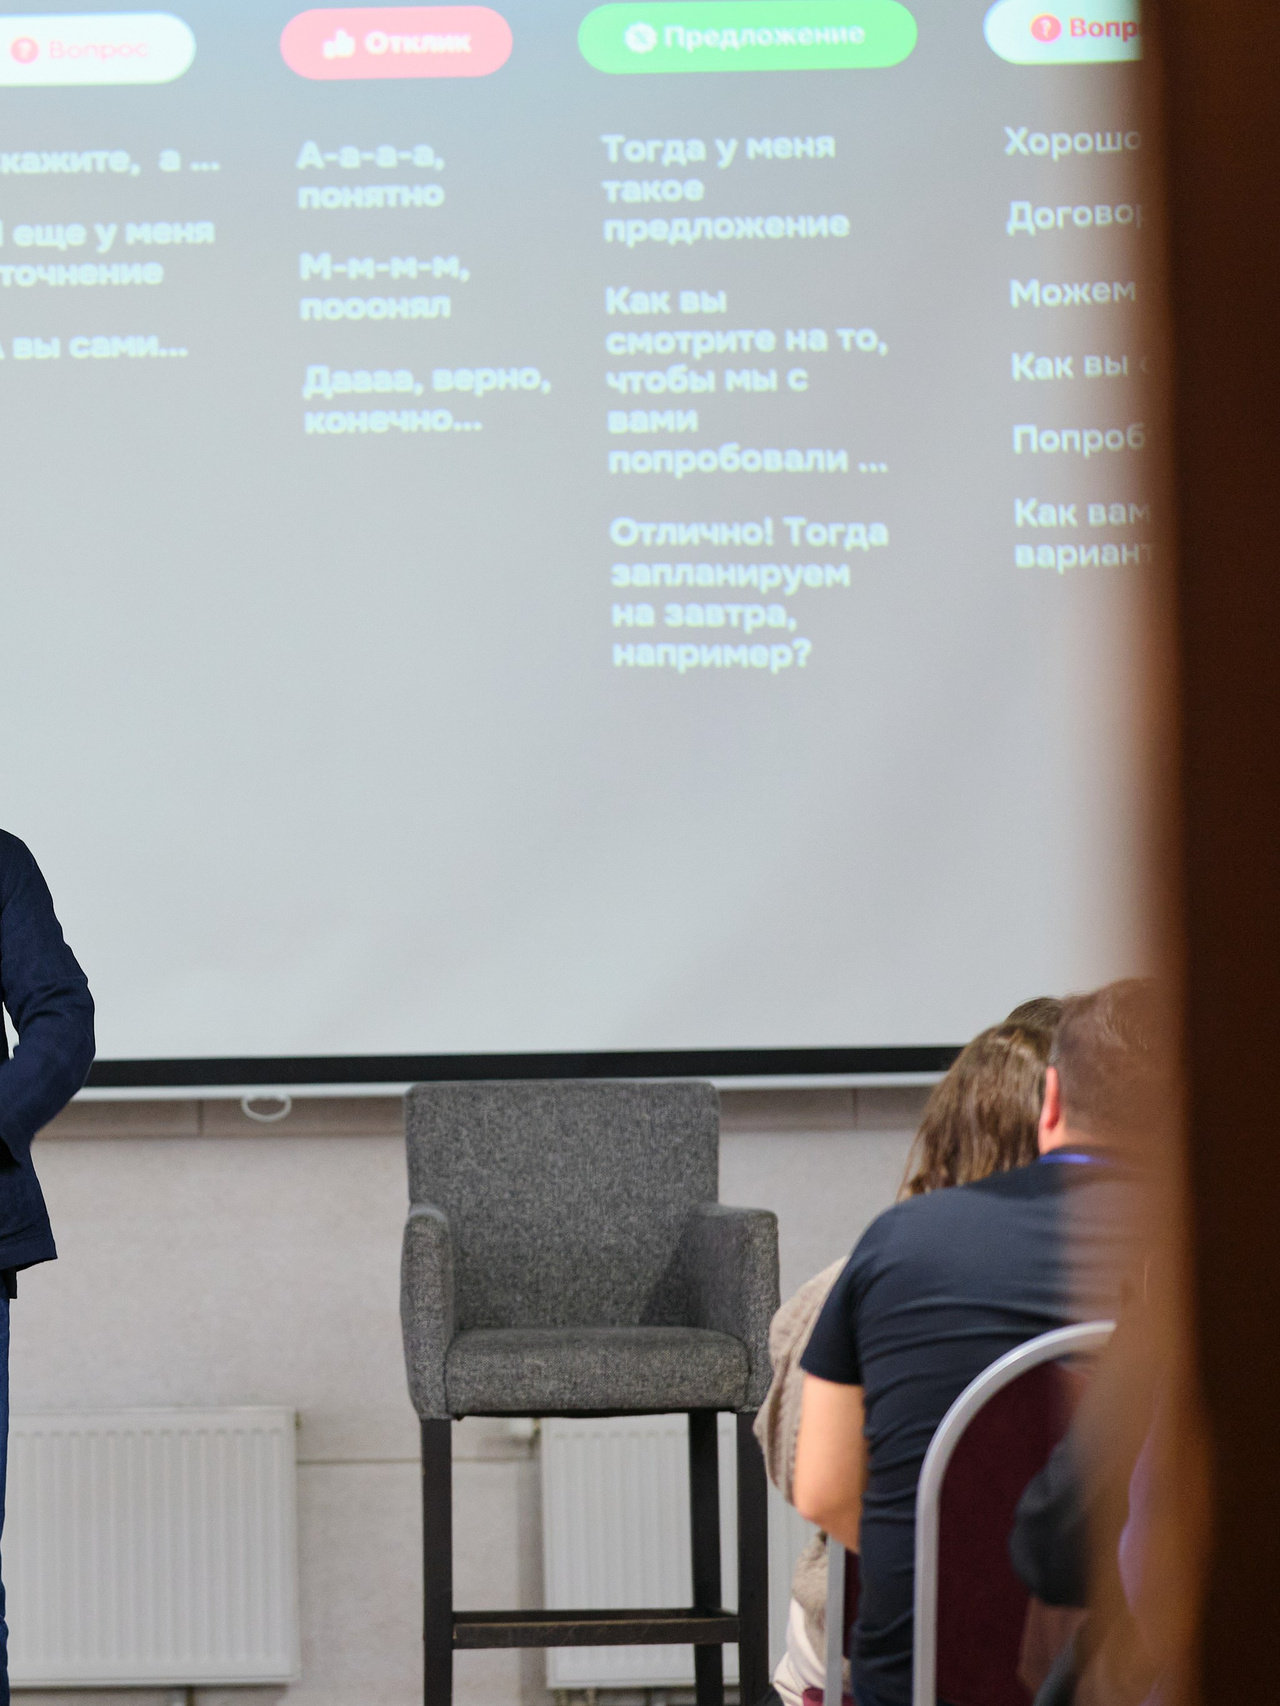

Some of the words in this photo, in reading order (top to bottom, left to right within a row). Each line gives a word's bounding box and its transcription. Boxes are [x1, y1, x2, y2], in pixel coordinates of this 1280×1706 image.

[48, 40, 150, 61] Вопрос
[365, 30, 472, 54] Отклик
[663, 25, 866, 52] Предложение
[158, 149, 181, 172] а
[296, 141, 445, 171] А-а-а-а,
[600, 134, 707, 167] Тогда
[714, 138, 739, 169] у
[746, 135, 836, 160] меня
[298, 184, 445, 209] понятно
[601, 179, 705, 203] такое
[12, 223, 87, 251] еще
[94, 223, 118, 254] у
[125, 221, 215, 245] меня
[603, 214, 851, 248] предложение
[299, 252, 470, 282] М-м-м-м,
[300, 296, 452, 321] пооонял
[605, 286, 671, 315] Как
[679, 290, 727, 314] вы
[1010, 278, 1136, 309] Можем
[12, 337, 61, 360] вы
[68, 335, 188, 359] сами...
[605, 329, 777, 360] смотрите
[785, 328, 829, 352] на
[836, 328, 888, 356] то,
[606, 364, 716, 394] чтобы
[725, 369, 778, 392] мы
[787, 368, 809, 392] с
[1011, 351, 1074, 381] Как
[1084, 355, 1129, 377] вы
[302, 365, 424, 400] Даааа,
[432, 367, 552, 397] верно,
[305, 409, 483, 435] конечно...
[607, 409, 698, 434] вами
[608, 442, 849, 480] попробовали
[1014, 497, 1078, 528] Как
[609, 516, 774, 547] Отлично!
[783, 516, 889, 552] Тогда
[611, 563, 851, 596] запланируем
[612, 603, 655, 627] на
[663, 604, 797, 634] завтра,
[613, 637, 812, 674] например?
